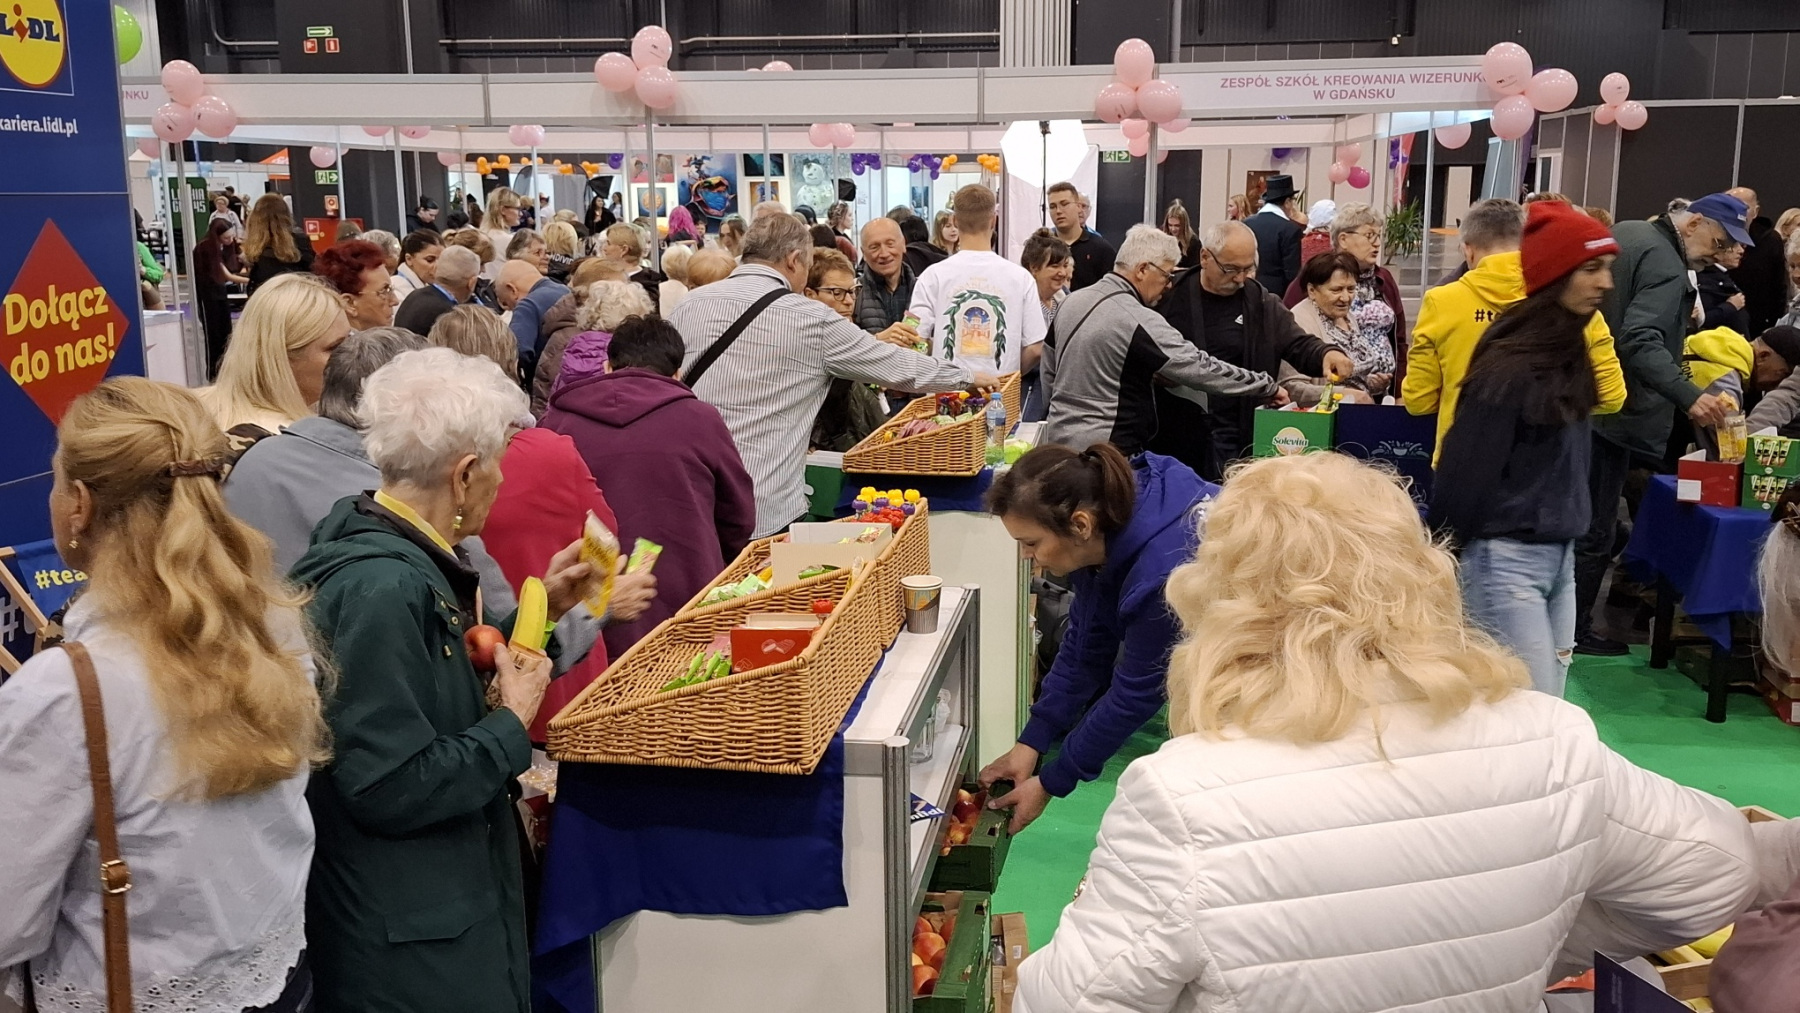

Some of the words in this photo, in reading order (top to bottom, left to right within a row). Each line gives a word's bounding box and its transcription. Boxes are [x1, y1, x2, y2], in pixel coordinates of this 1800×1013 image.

[1220, 75, 1272, 88] ZESPÓŁ
[1275, 73, 1320, 87] SZKÓŁ
[1323, 73, 1406, 86] KREOWANIA
[1409, 71, 1486, 84] WIZERUNK
[1313, 90, 1325, 100] W
[1329, 86, 1396, 100] GDAŃSKU
[3, 284, 109, 335] Dołącz
[10, 342, 50, 386] do
[54, 322, 115, 374] nas!
